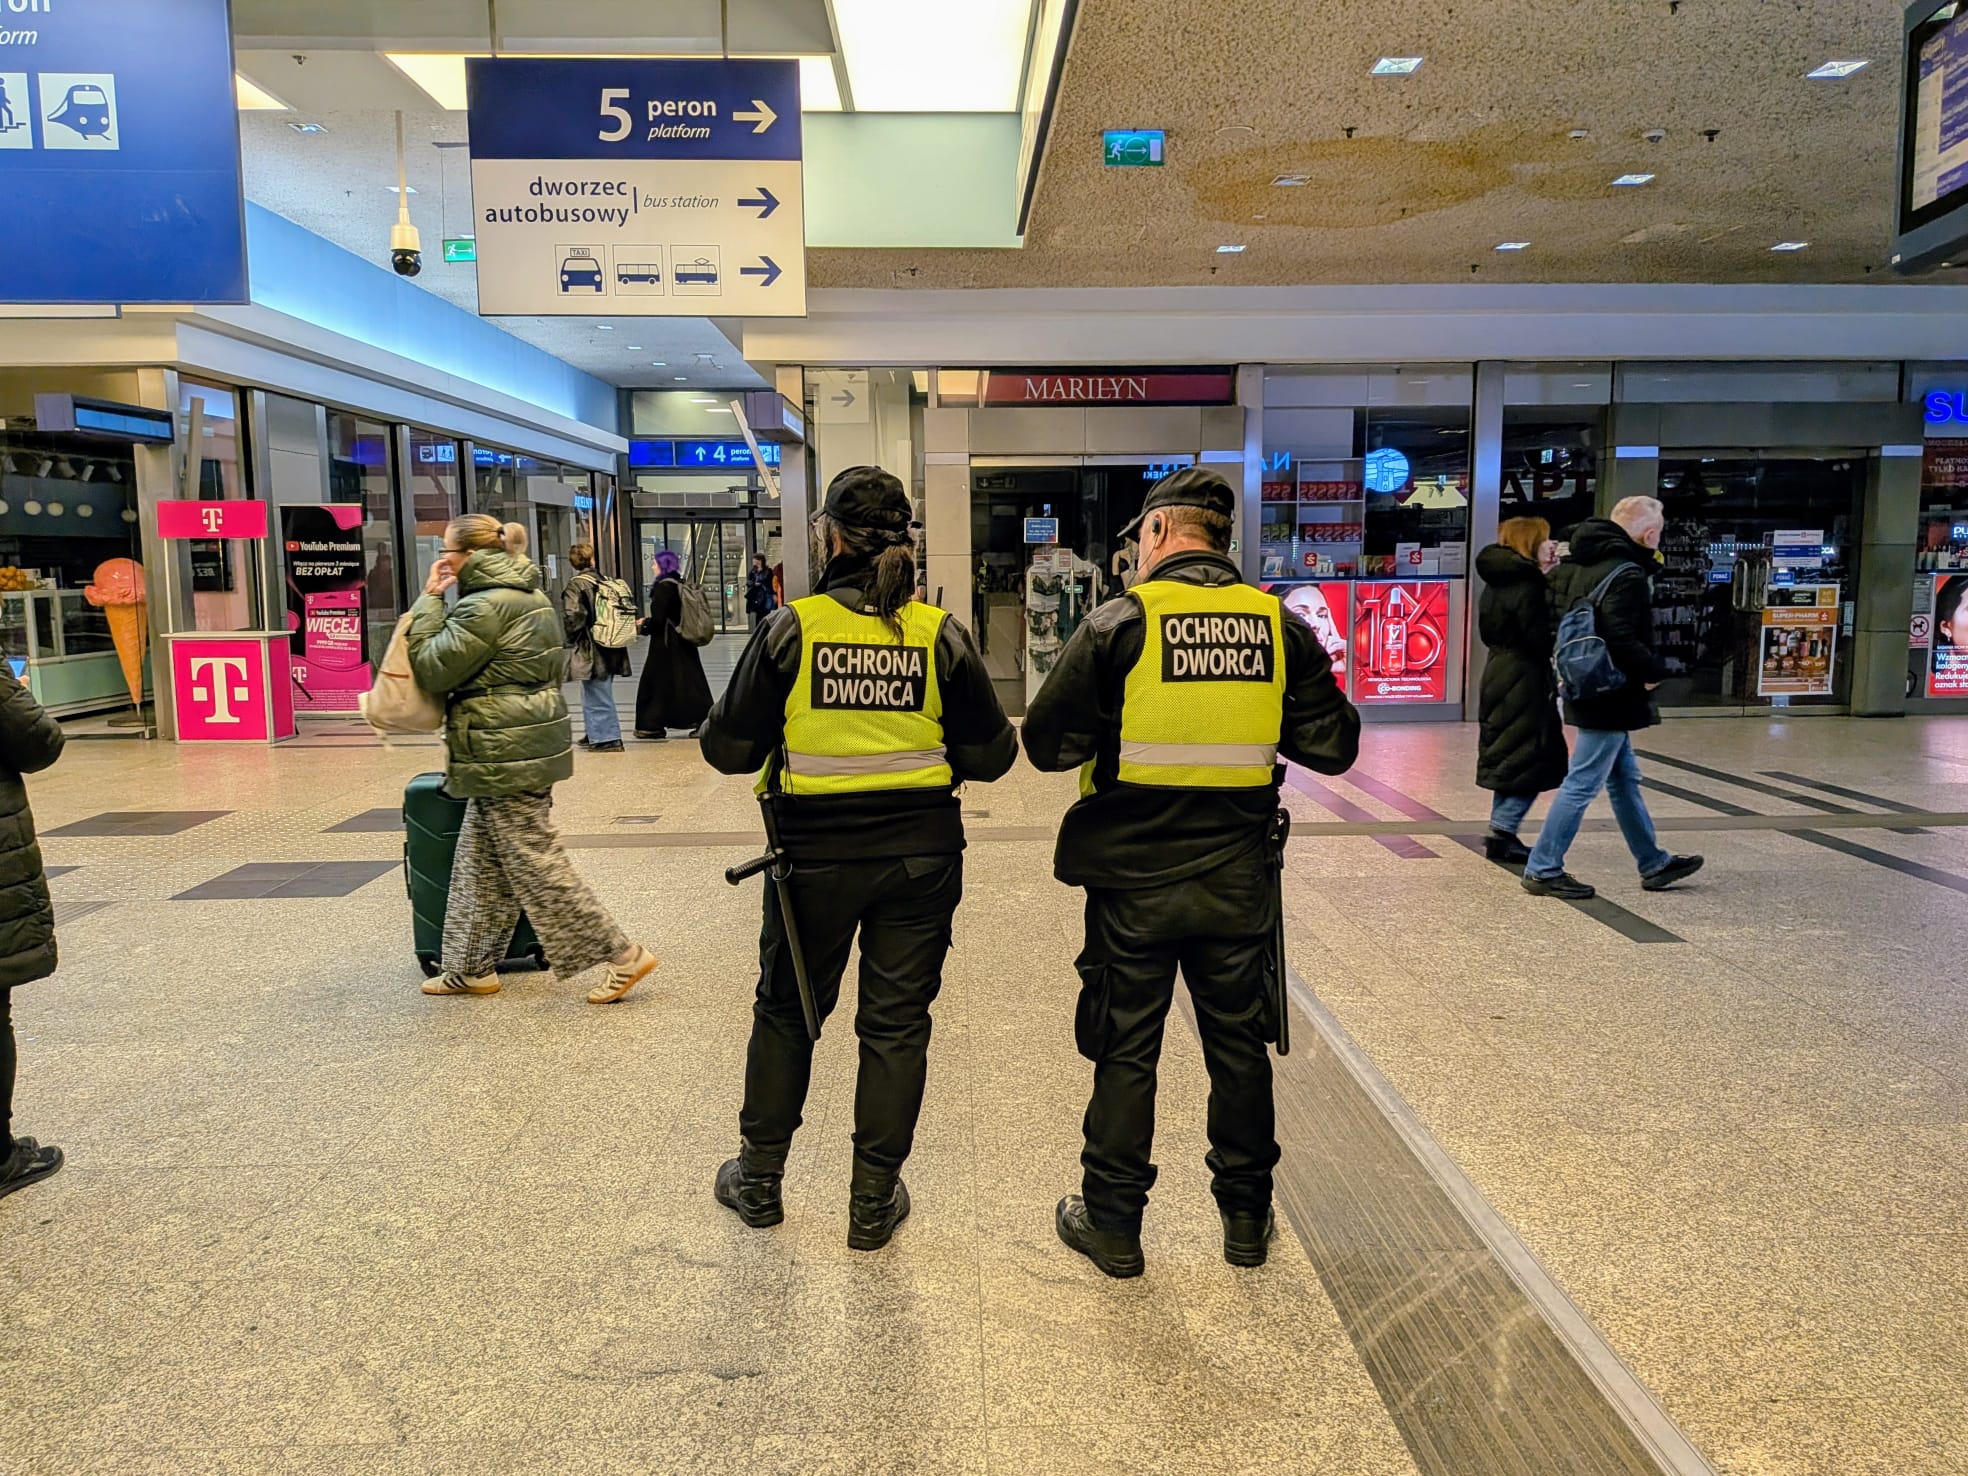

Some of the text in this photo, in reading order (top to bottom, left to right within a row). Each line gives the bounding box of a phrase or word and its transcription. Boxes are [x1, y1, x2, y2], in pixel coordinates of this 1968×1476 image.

[598, 88, 717, 142] 5 peron
[648, 124, 710, 141] platform
[529, 176, 628, 196] dworzec
[643, 194, 719, 209] bus station
[485, 203, 629, 228] autobusowy
[1024, 377, 1148, 399] MARILYN
[713, 445, 752, 462] 4 peron
[202, 508, 223, 533] T
[300, 541, 360, 551] YouTube Premium
[296, 567, 344, 576] BEZ OPŁAT
[306, 617, 360, 635] WIĘCEJ
[1165, 617, 1271, 645] OCHRONA
[817, 647, 923, 678] OCHRONA
[1173, 648, 1266, 676] DWORCA
[190, 657, 249, 723] T
[822, 678, 915, 707] DWORCA
